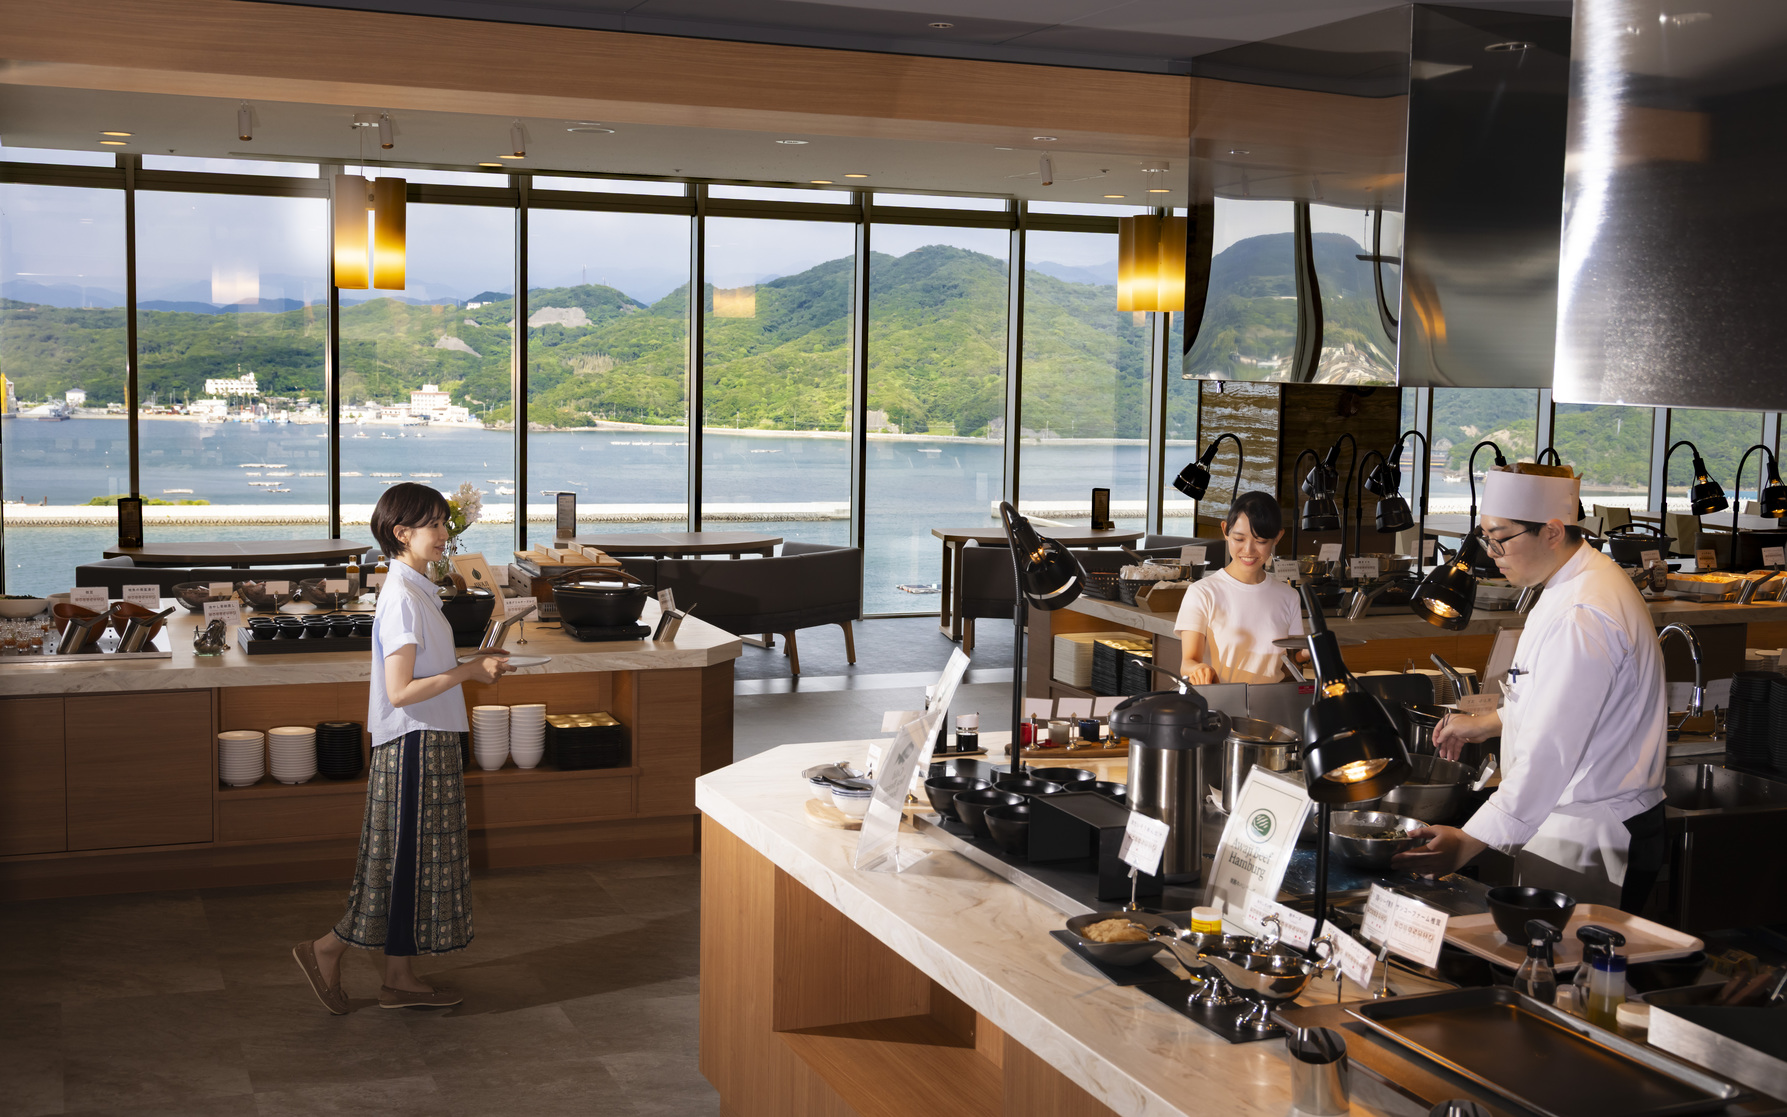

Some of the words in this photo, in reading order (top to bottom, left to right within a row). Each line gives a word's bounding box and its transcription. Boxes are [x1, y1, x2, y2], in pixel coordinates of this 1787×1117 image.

[1231, 838, 1255, 858] Awaji
[1252, 845, 1275, 865] Beef
[1228, 851, 1266, 882] Hamburg
